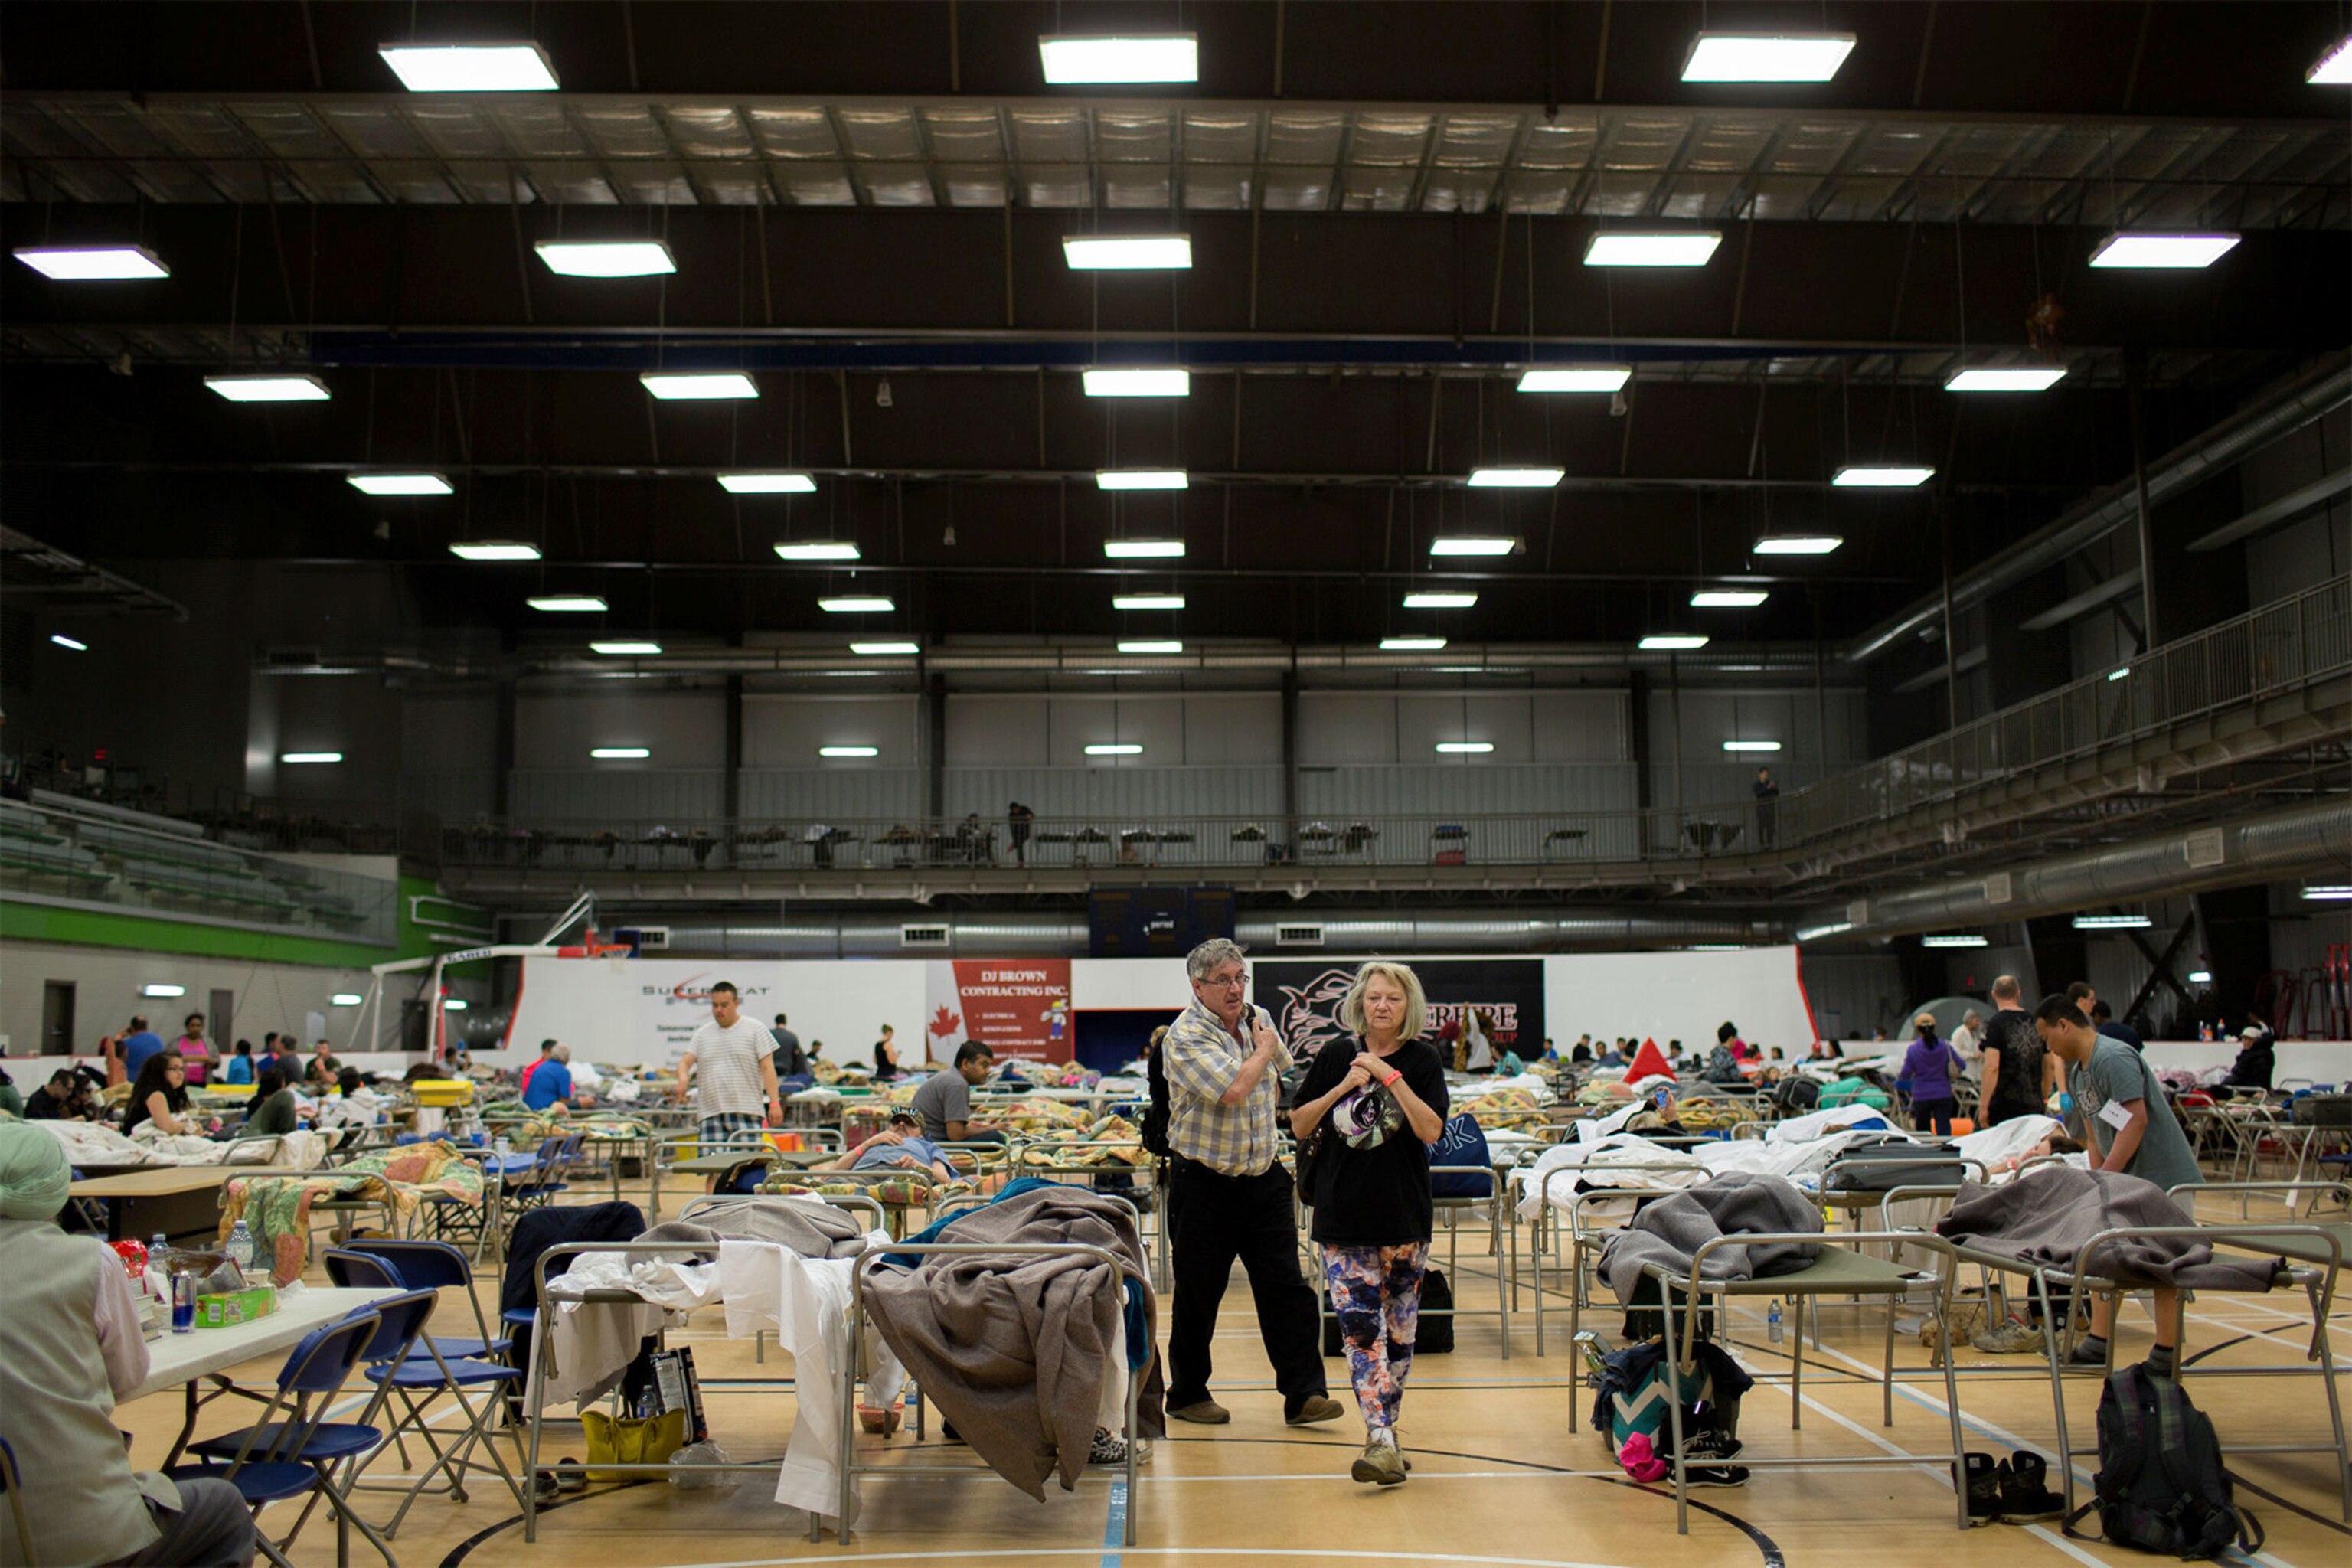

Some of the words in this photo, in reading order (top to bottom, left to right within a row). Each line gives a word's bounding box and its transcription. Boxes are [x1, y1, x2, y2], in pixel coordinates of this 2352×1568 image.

[982, 971, 997, 982] DJ
[999, 971, 1047, 982] BROWN
[961, 986, 1042, 996] CONTRACTING
[1044, 986, 1068, 996] INC.
